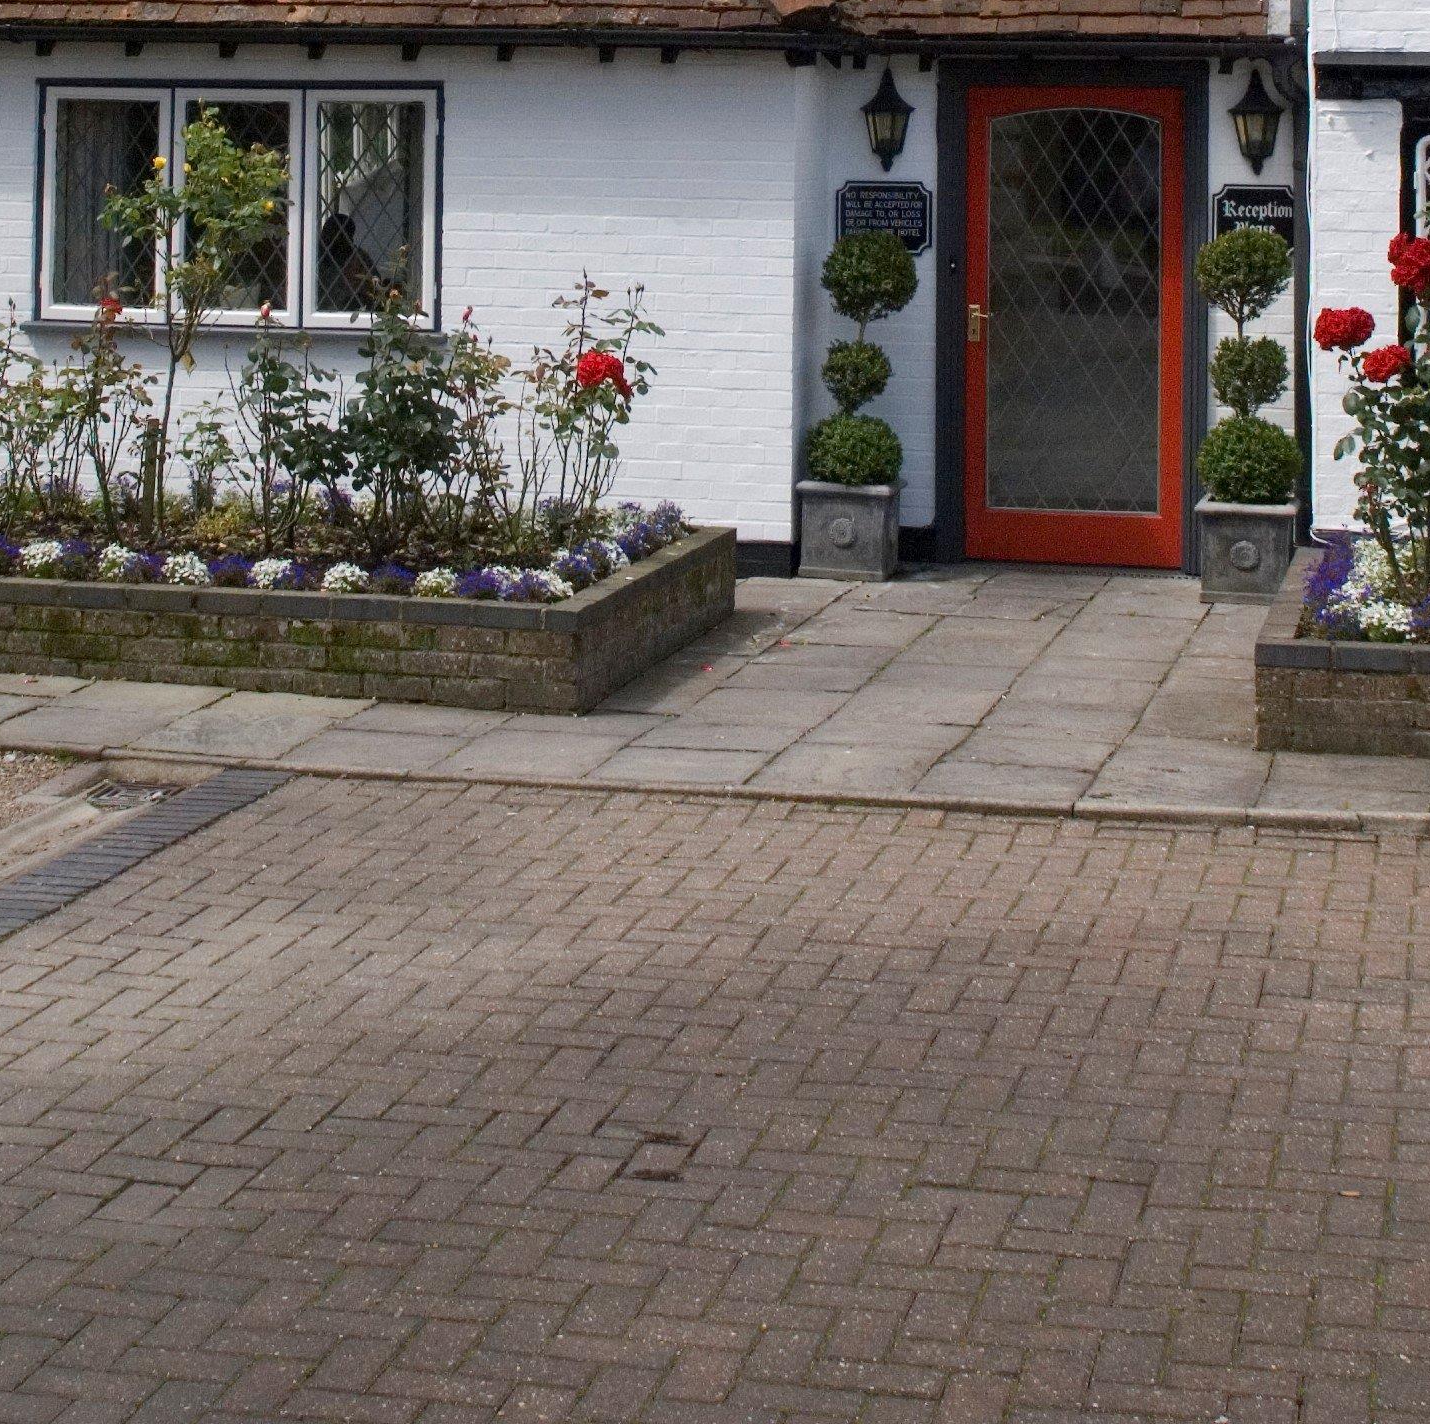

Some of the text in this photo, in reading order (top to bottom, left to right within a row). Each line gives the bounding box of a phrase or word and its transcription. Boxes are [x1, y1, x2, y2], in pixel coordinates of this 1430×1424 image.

[845, 210, 873, 218] DAMAGE
[888, 210, 898, 218] OR
[901, 210, 921, 218] LOSS
[1222, 199, 1293, 222] Reception
[868, 219, 889, 227] FROM
[890, 219, 923, 227] VEHICLES
[897, 228, 921, 237] HOTEL
